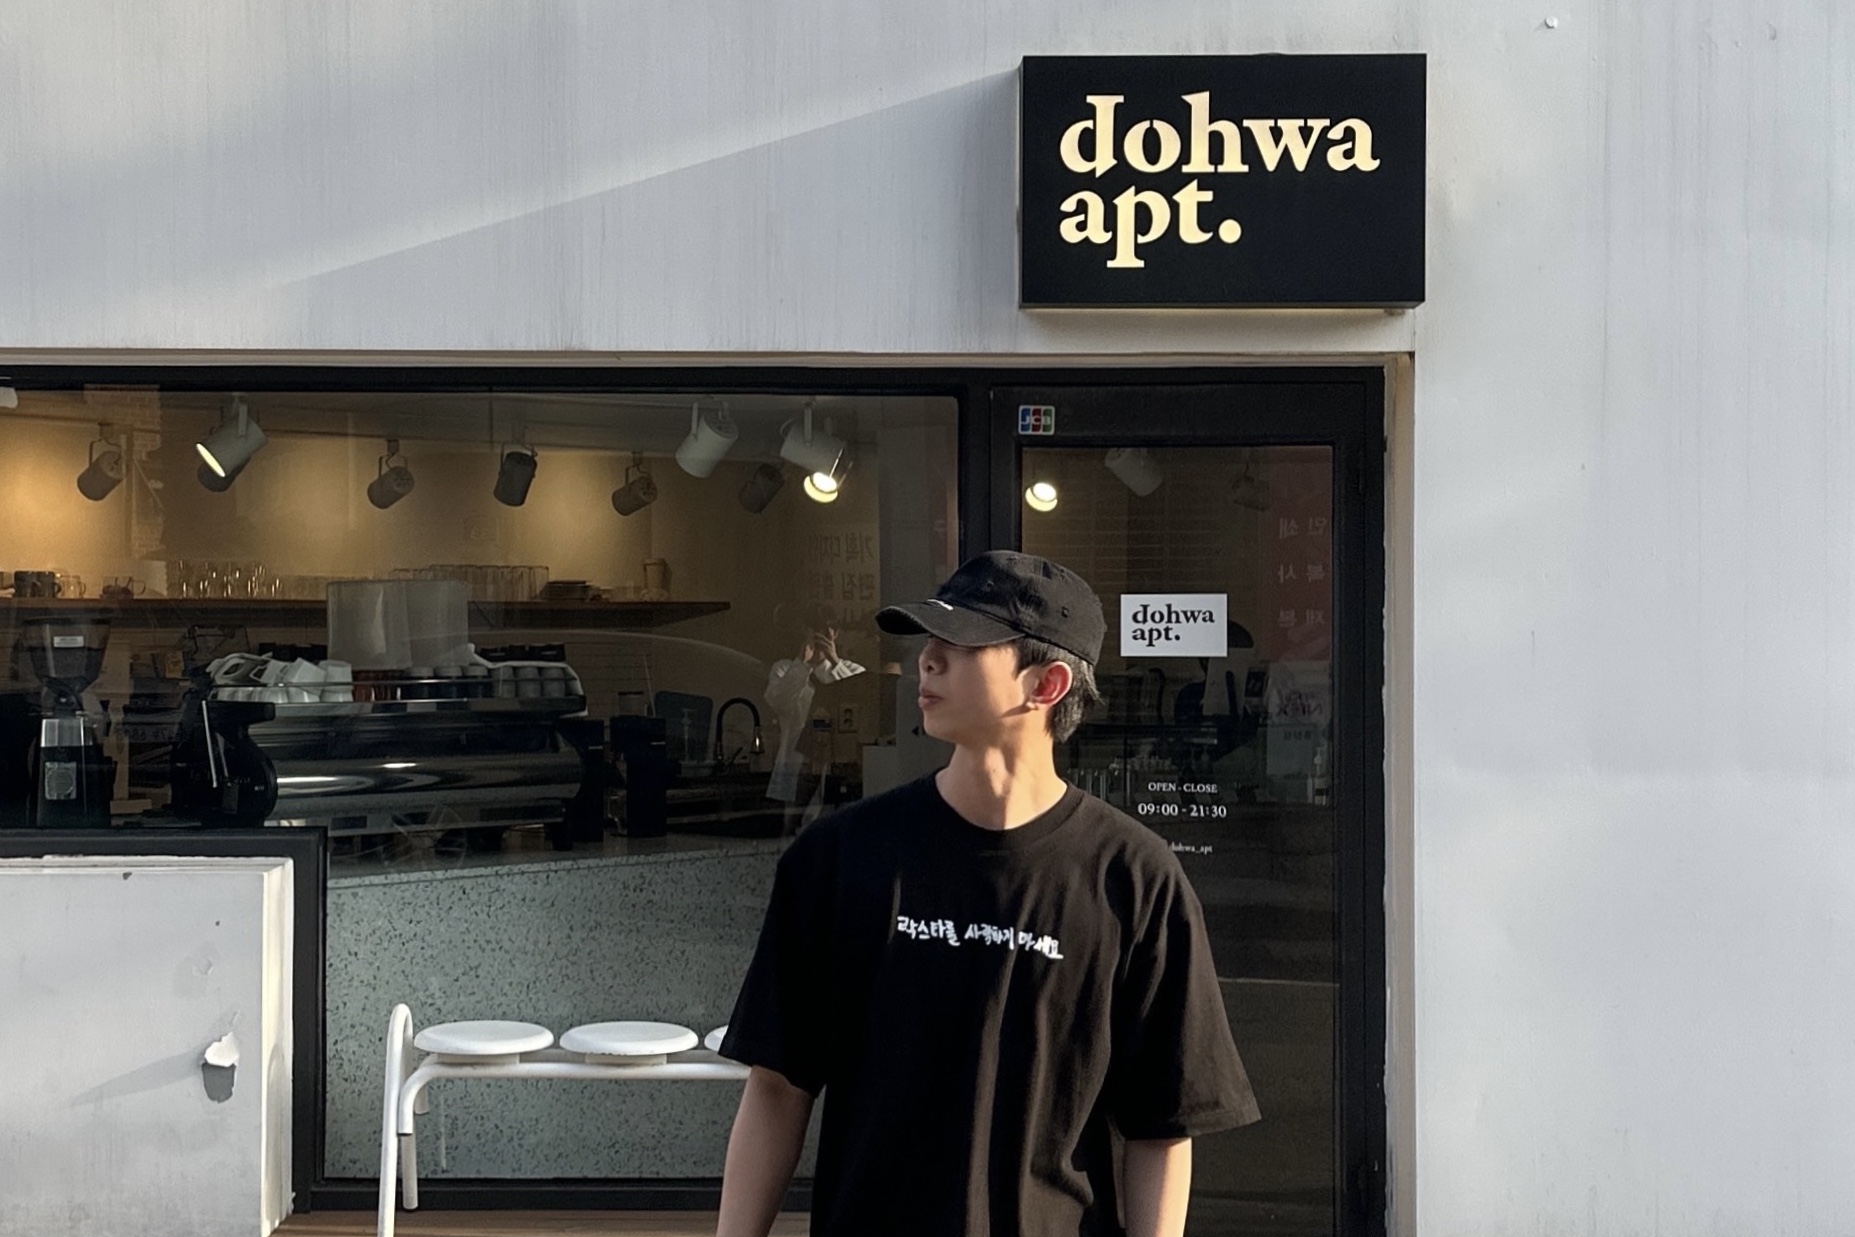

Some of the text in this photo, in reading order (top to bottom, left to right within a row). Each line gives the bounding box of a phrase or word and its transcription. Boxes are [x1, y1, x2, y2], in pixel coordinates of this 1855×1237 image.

[1060, 91, 1381, 178] dohwa
[1060, 179, 1242, 268] apt.
[1131, 603, 1215, 625] dohwa
[1131, 625, 1181, 648] apt.
[1147, 781, 1177, 792] OPEN
[1183, 783, 1218, 793] CLOSE
[1137, 803, 1179, 816] 09:00
[1189, 804, 1227, 818] 21:30
[896, 915, 961, 946] 락스타를
[1018, 930, 1064, 960] 마세요
